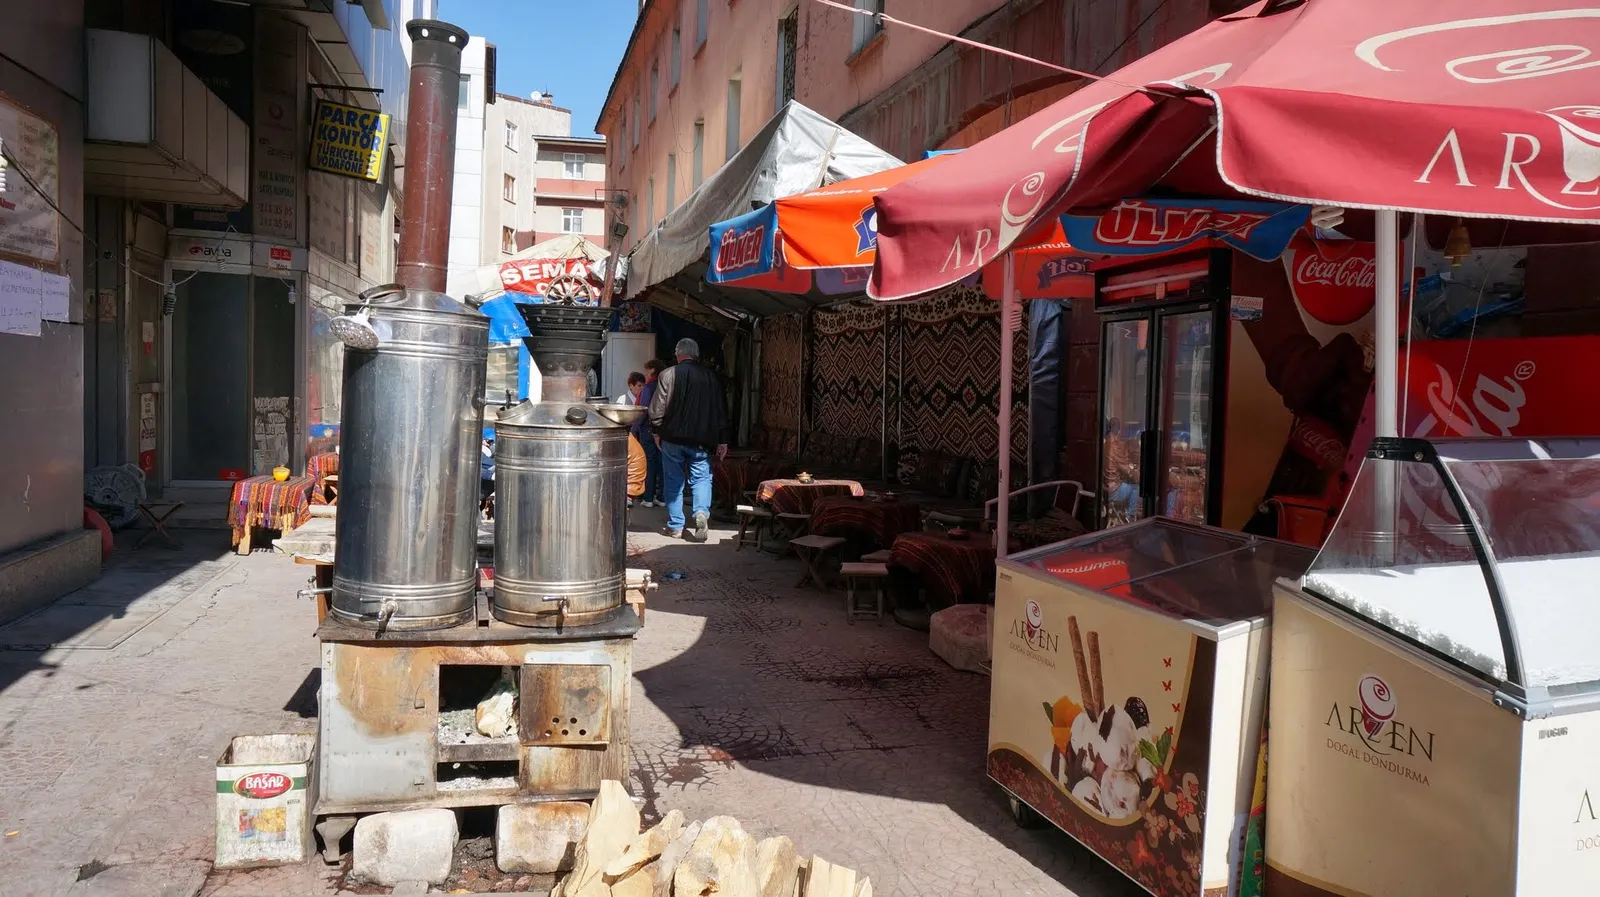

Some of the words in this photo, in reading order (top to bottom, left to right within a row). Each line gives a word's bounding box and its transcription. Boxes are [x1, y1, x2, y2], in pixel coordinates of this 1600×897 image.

[320, 106, 383, 134] PARÇA
[318, 123, 381, 152] KONTÖR
[318, 153, 363, 174] VODAFONE
[203, 247, 232, 257] ava
[716, 225, 755, 273] ÜLKER
[501, 262, 591, 284] SEMA
[1296, 253, 1376, 287] Coca-Cola
[1324, 701, 1436, 763] ARZEN
[1326, 738, 1360, 759] DOĞAL
[1363, 752, 1431, 787] DONDURMA
[245, 775, 284, 790] BAŞAR
